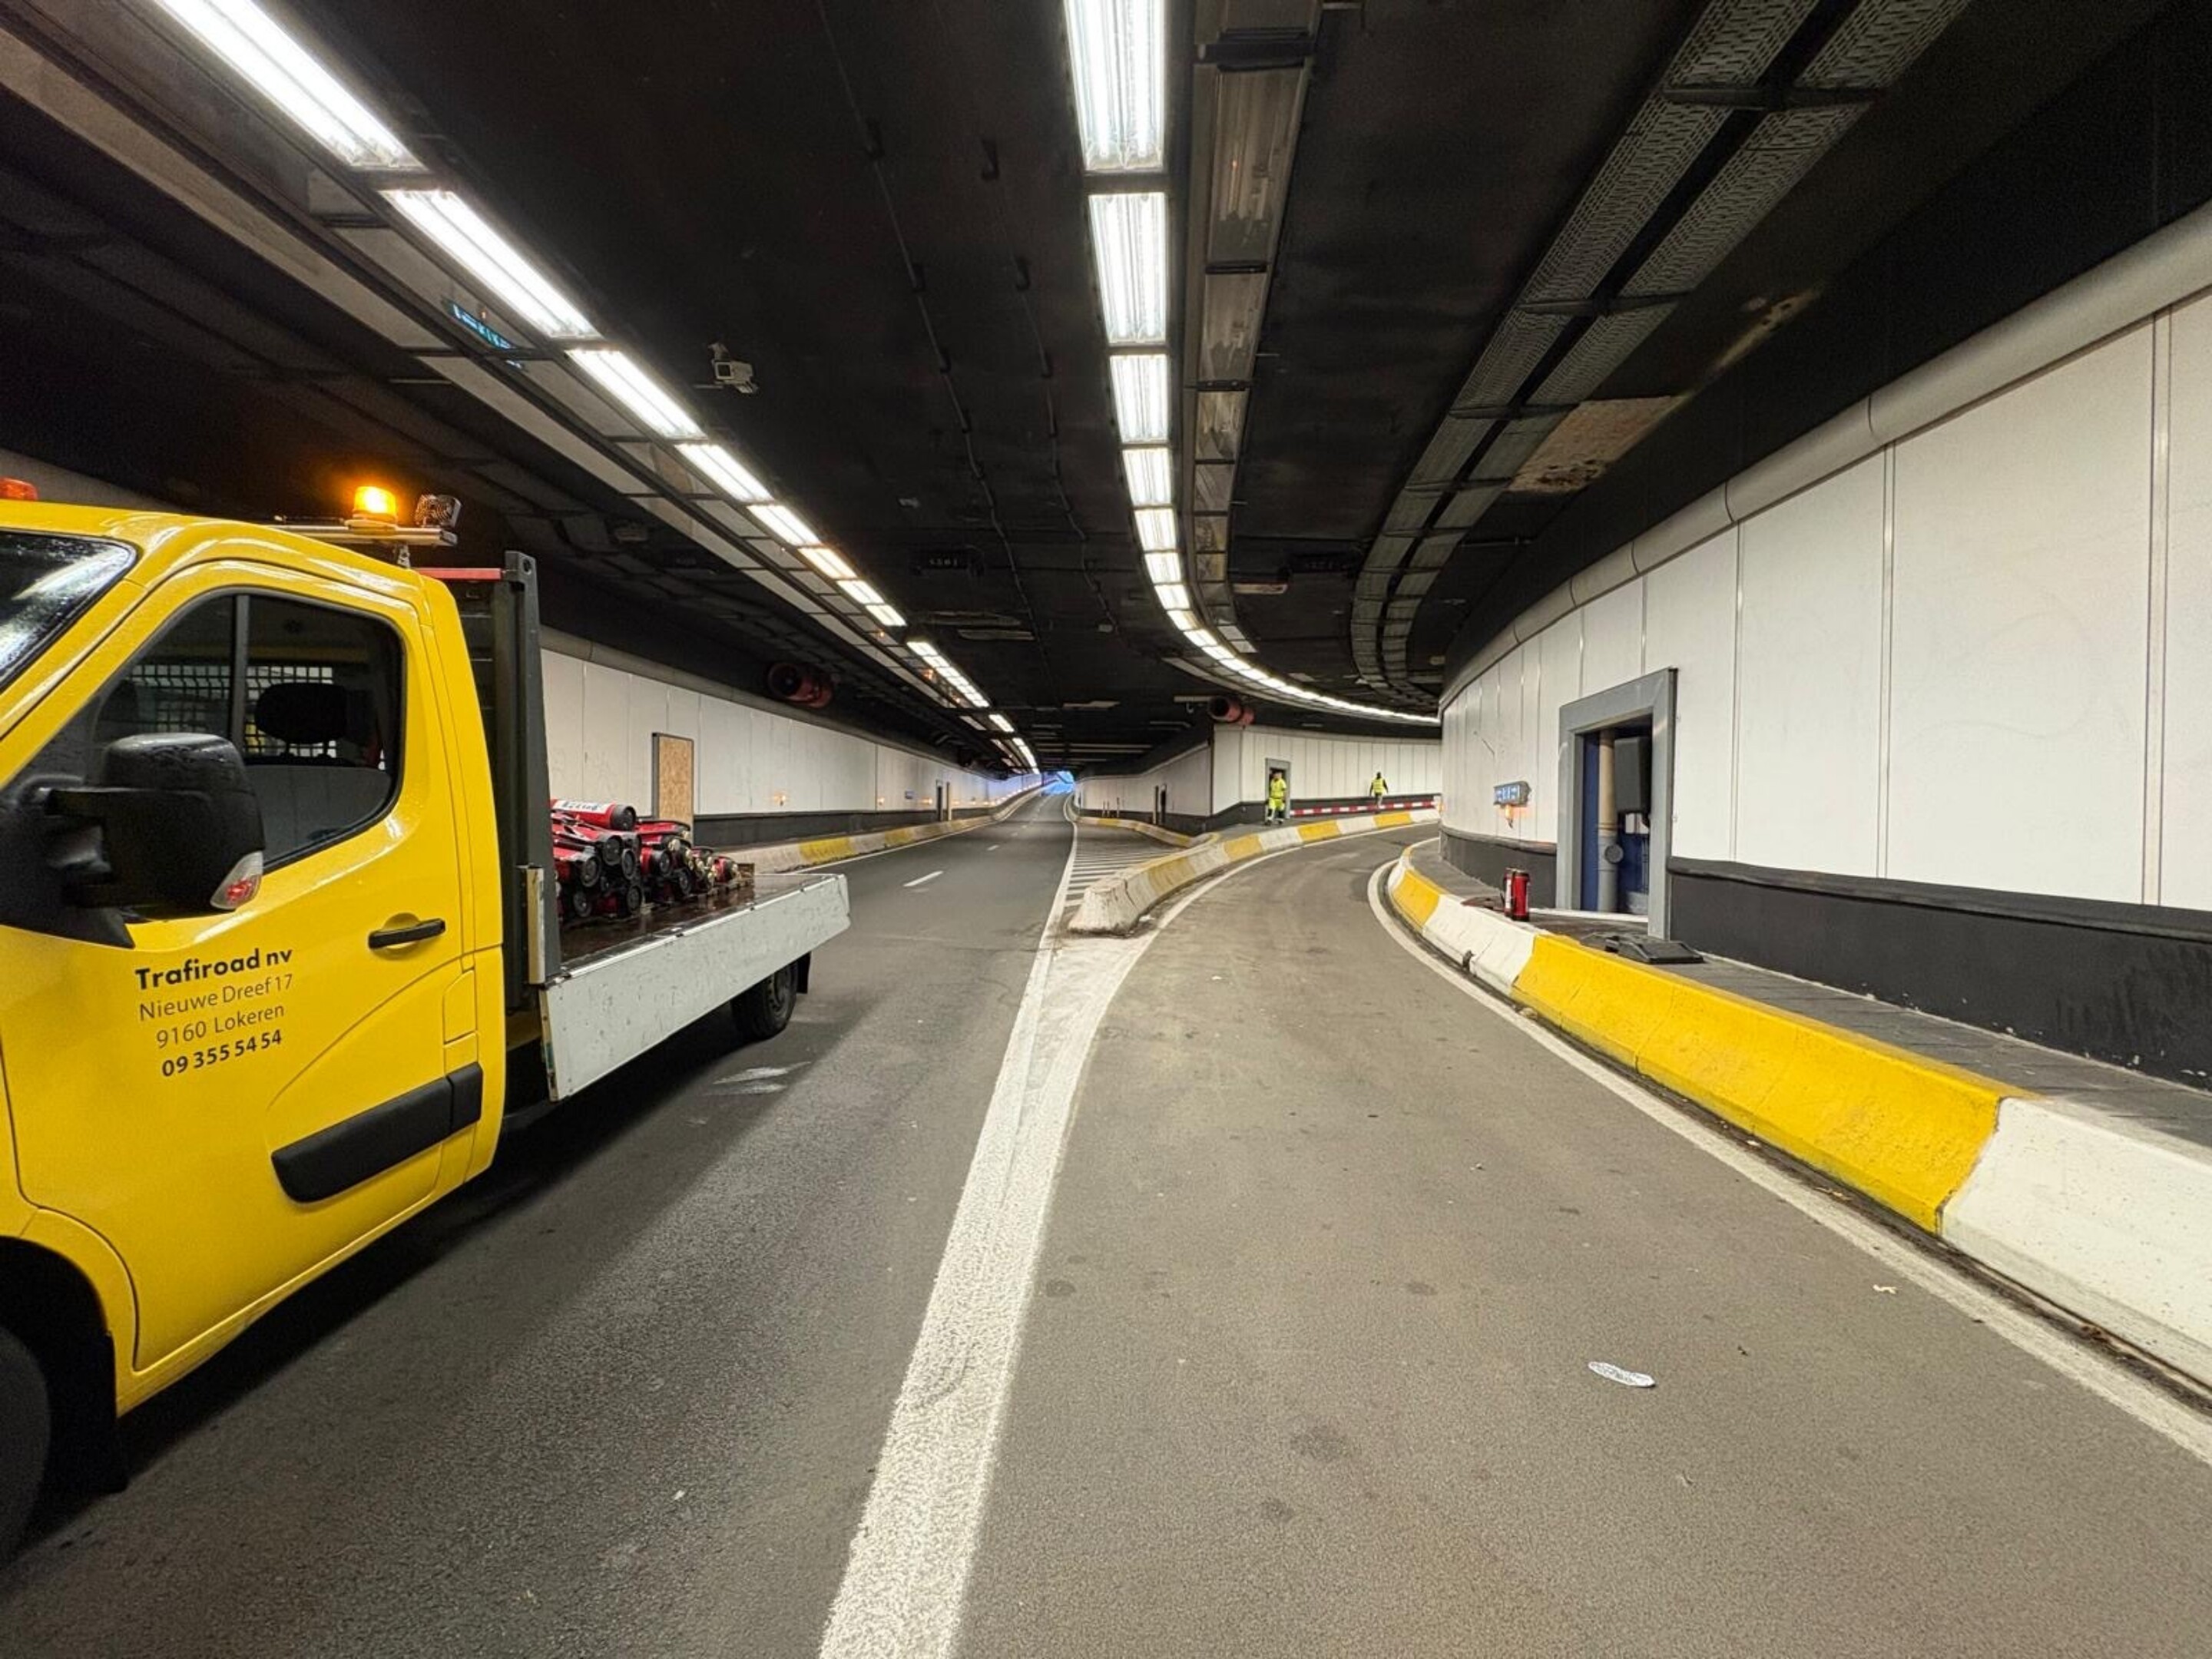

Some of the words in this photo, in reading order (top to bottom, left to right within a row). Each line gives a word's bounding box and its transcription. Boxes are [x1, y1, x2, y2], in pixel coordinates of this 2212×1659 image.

[134, 948, 260, 990] Trafiroad
[266, 949, 293, 966] nv
[139, 992, 218, 1022] Nieuwe
[223, 977, 271, 1004] Dreef
[275, 973, 293, 992] 17
[156, 1021, 207, 1049] 9160
[214, 1005, 284, 1033] Lokeren
[161, 1055, 188, 1077] 09
[194, 1045, 230, 1068] 355
